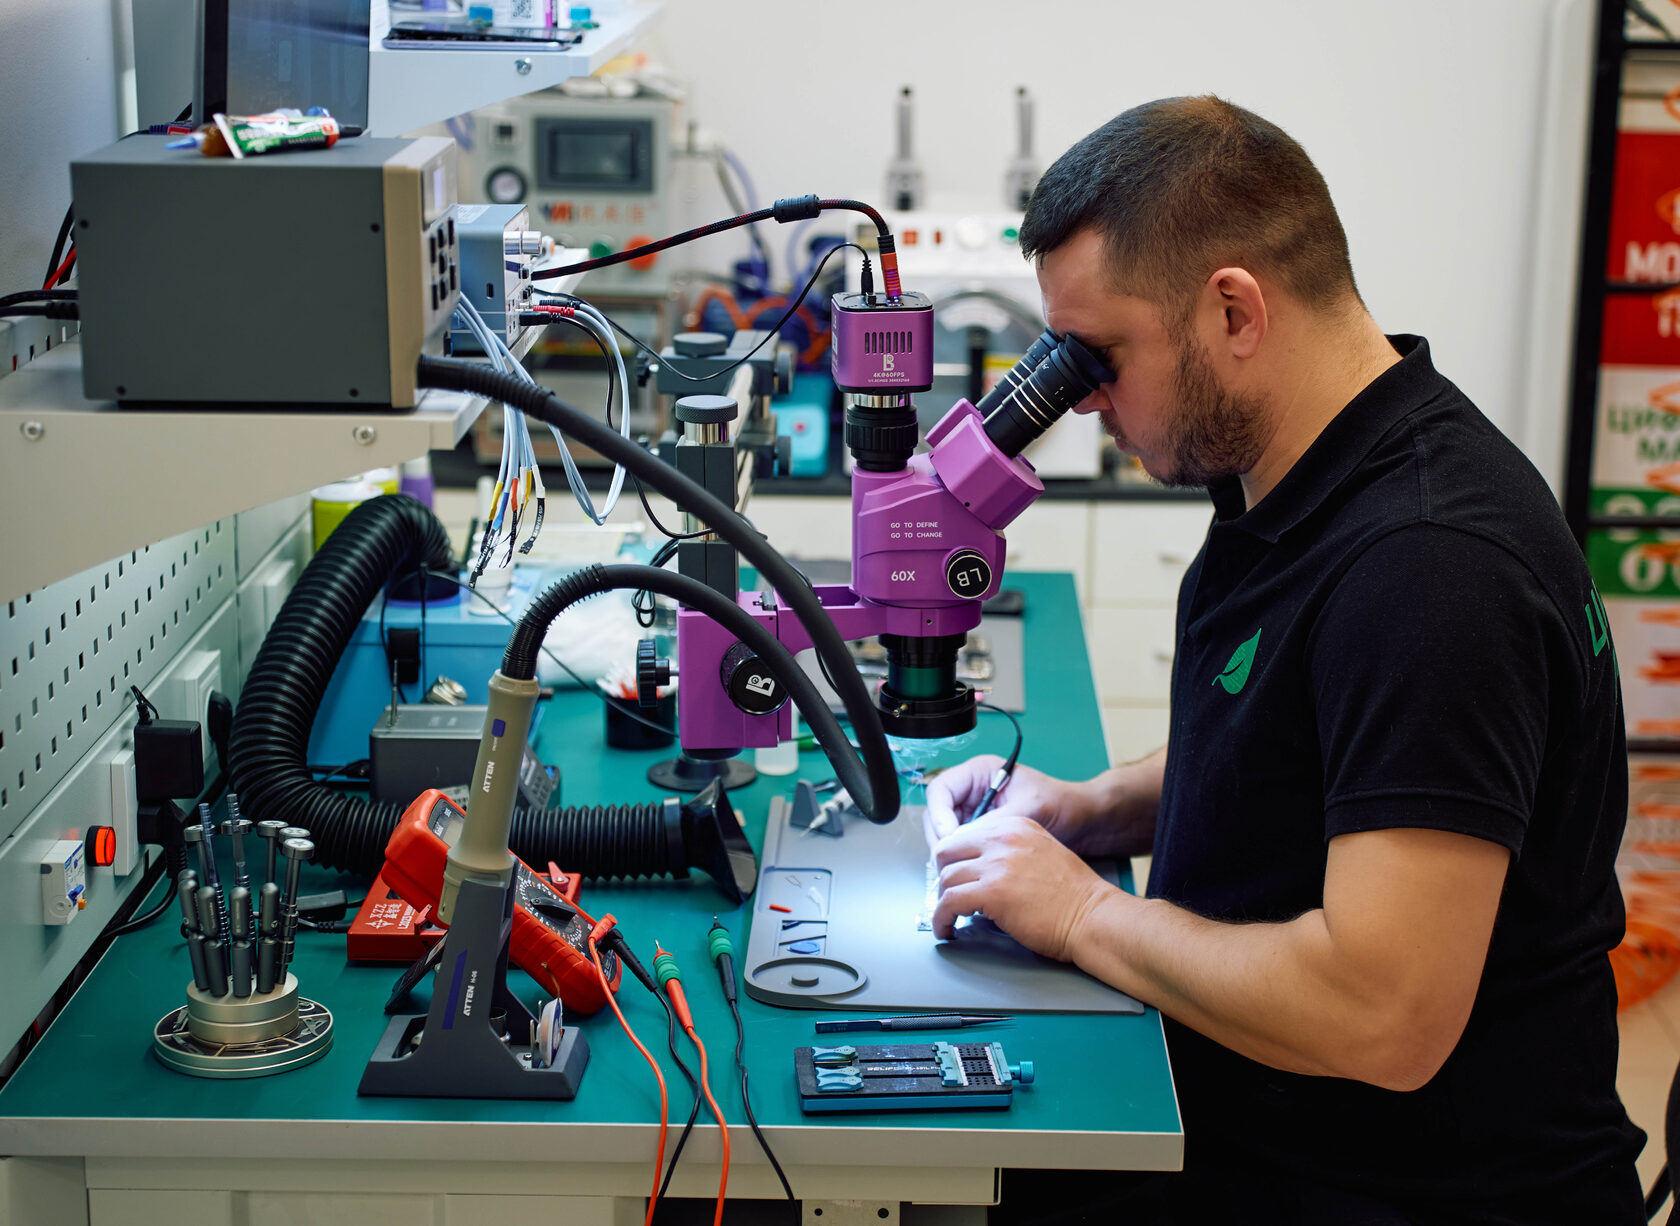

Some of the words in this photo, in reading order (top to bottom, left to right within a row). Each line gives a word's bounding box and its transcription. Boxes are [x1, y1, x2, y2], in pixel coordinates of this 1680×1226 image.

[891, 570, 916, 581] 60X
[482, 761, 495, 793] ATTEN
[369, 903, 387, 919] XZZ
[463, 985, 475, 1016] ATTEN
